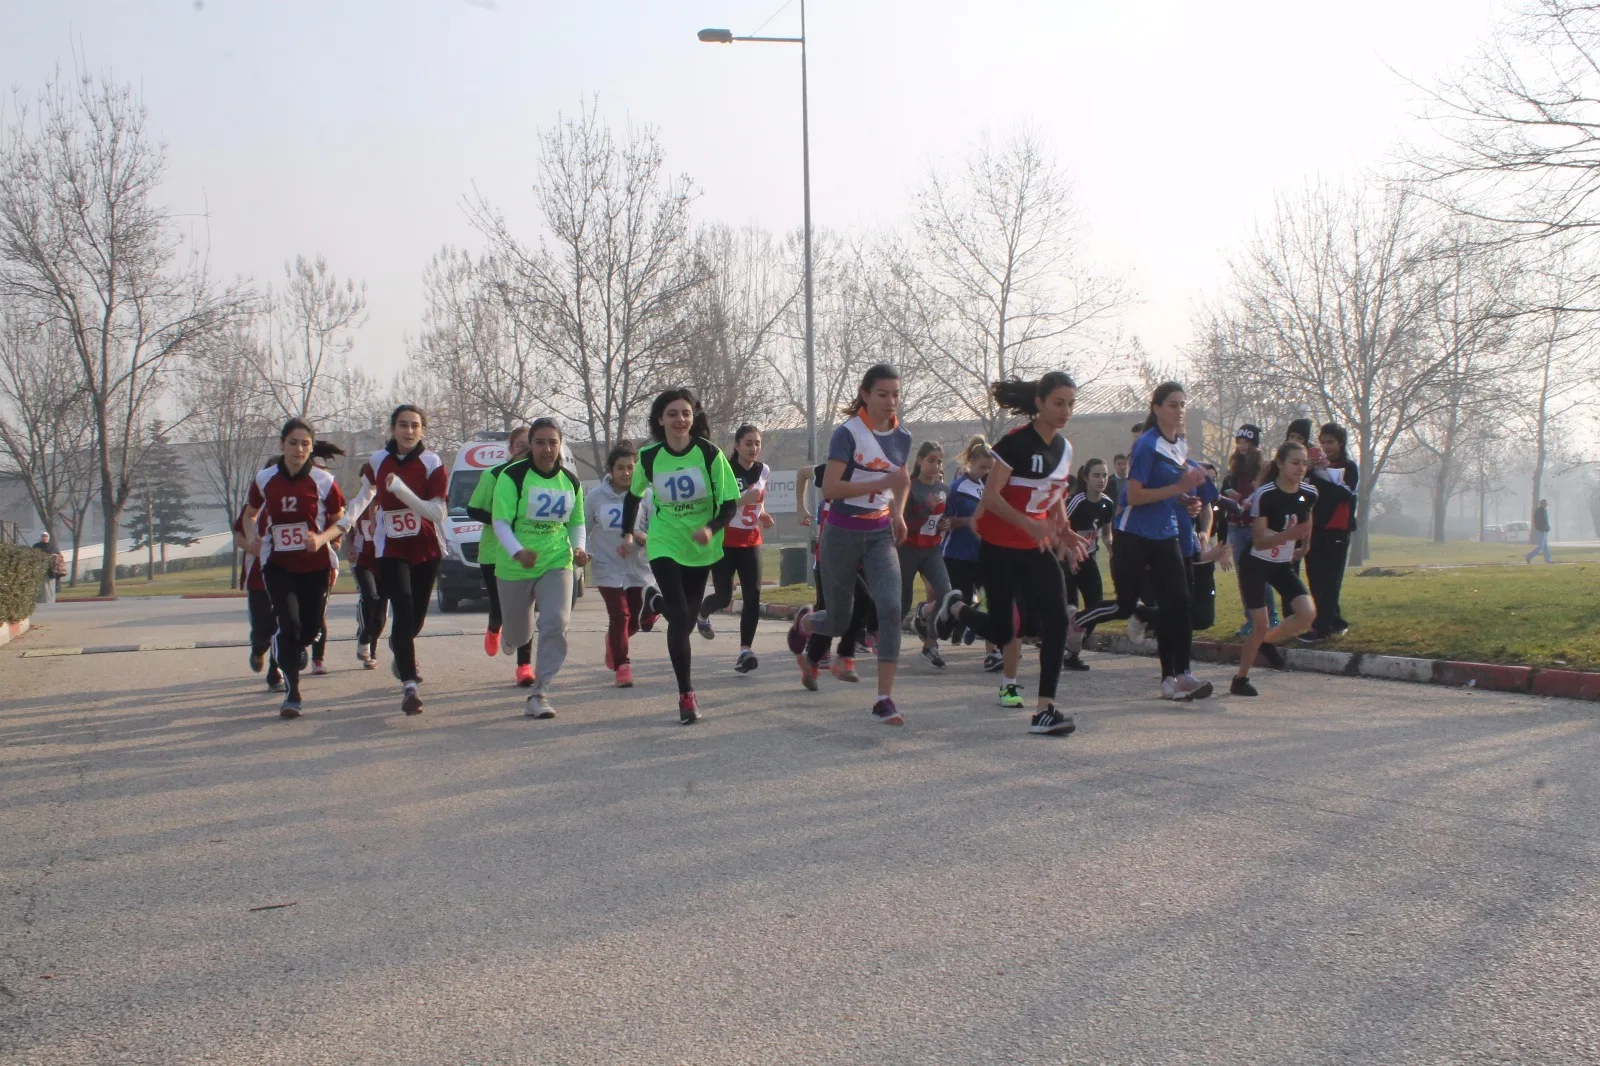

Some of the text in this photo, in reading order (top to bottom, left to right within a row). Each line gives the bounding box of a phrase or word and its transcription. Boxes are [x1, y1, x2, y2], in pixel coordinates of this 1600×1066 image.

[478, 450, 504, 459] 112
[1031, 454, 1043, 473] 11
[664, 475, 695, 501] 19
[280, 496, 297, 512] 12
[536, 493, 566, 518] 24
[392, 513, 416, 532] 56
[742, 504, 758, 527] 5
[281, 528, 303, 546] 55
